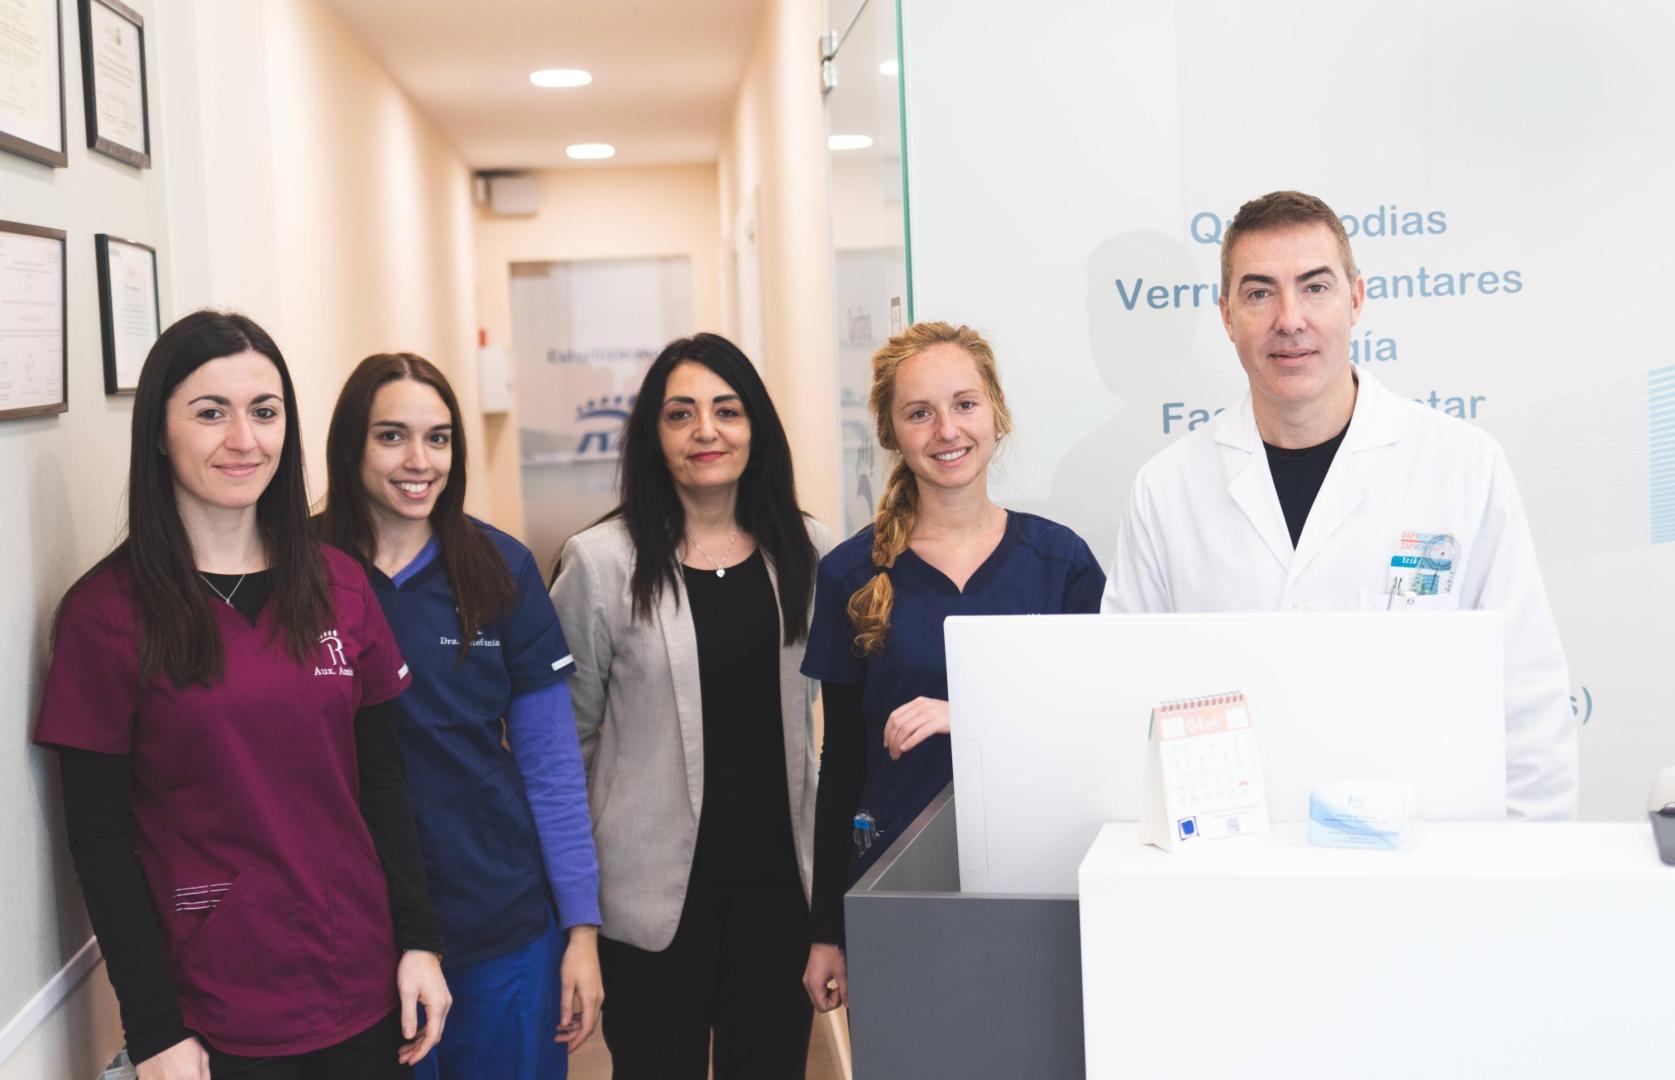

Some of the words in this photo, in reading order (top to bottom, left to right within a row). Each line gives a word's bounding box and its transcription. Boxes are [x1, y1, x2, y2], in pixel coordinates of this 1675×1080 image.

[1190, 204, 1447, 246] Qodias
[1115, 278, 1221, 310] Verr
[1357, 266, 1523, 300] antares
[439, 636, 460, 646] Dra.
